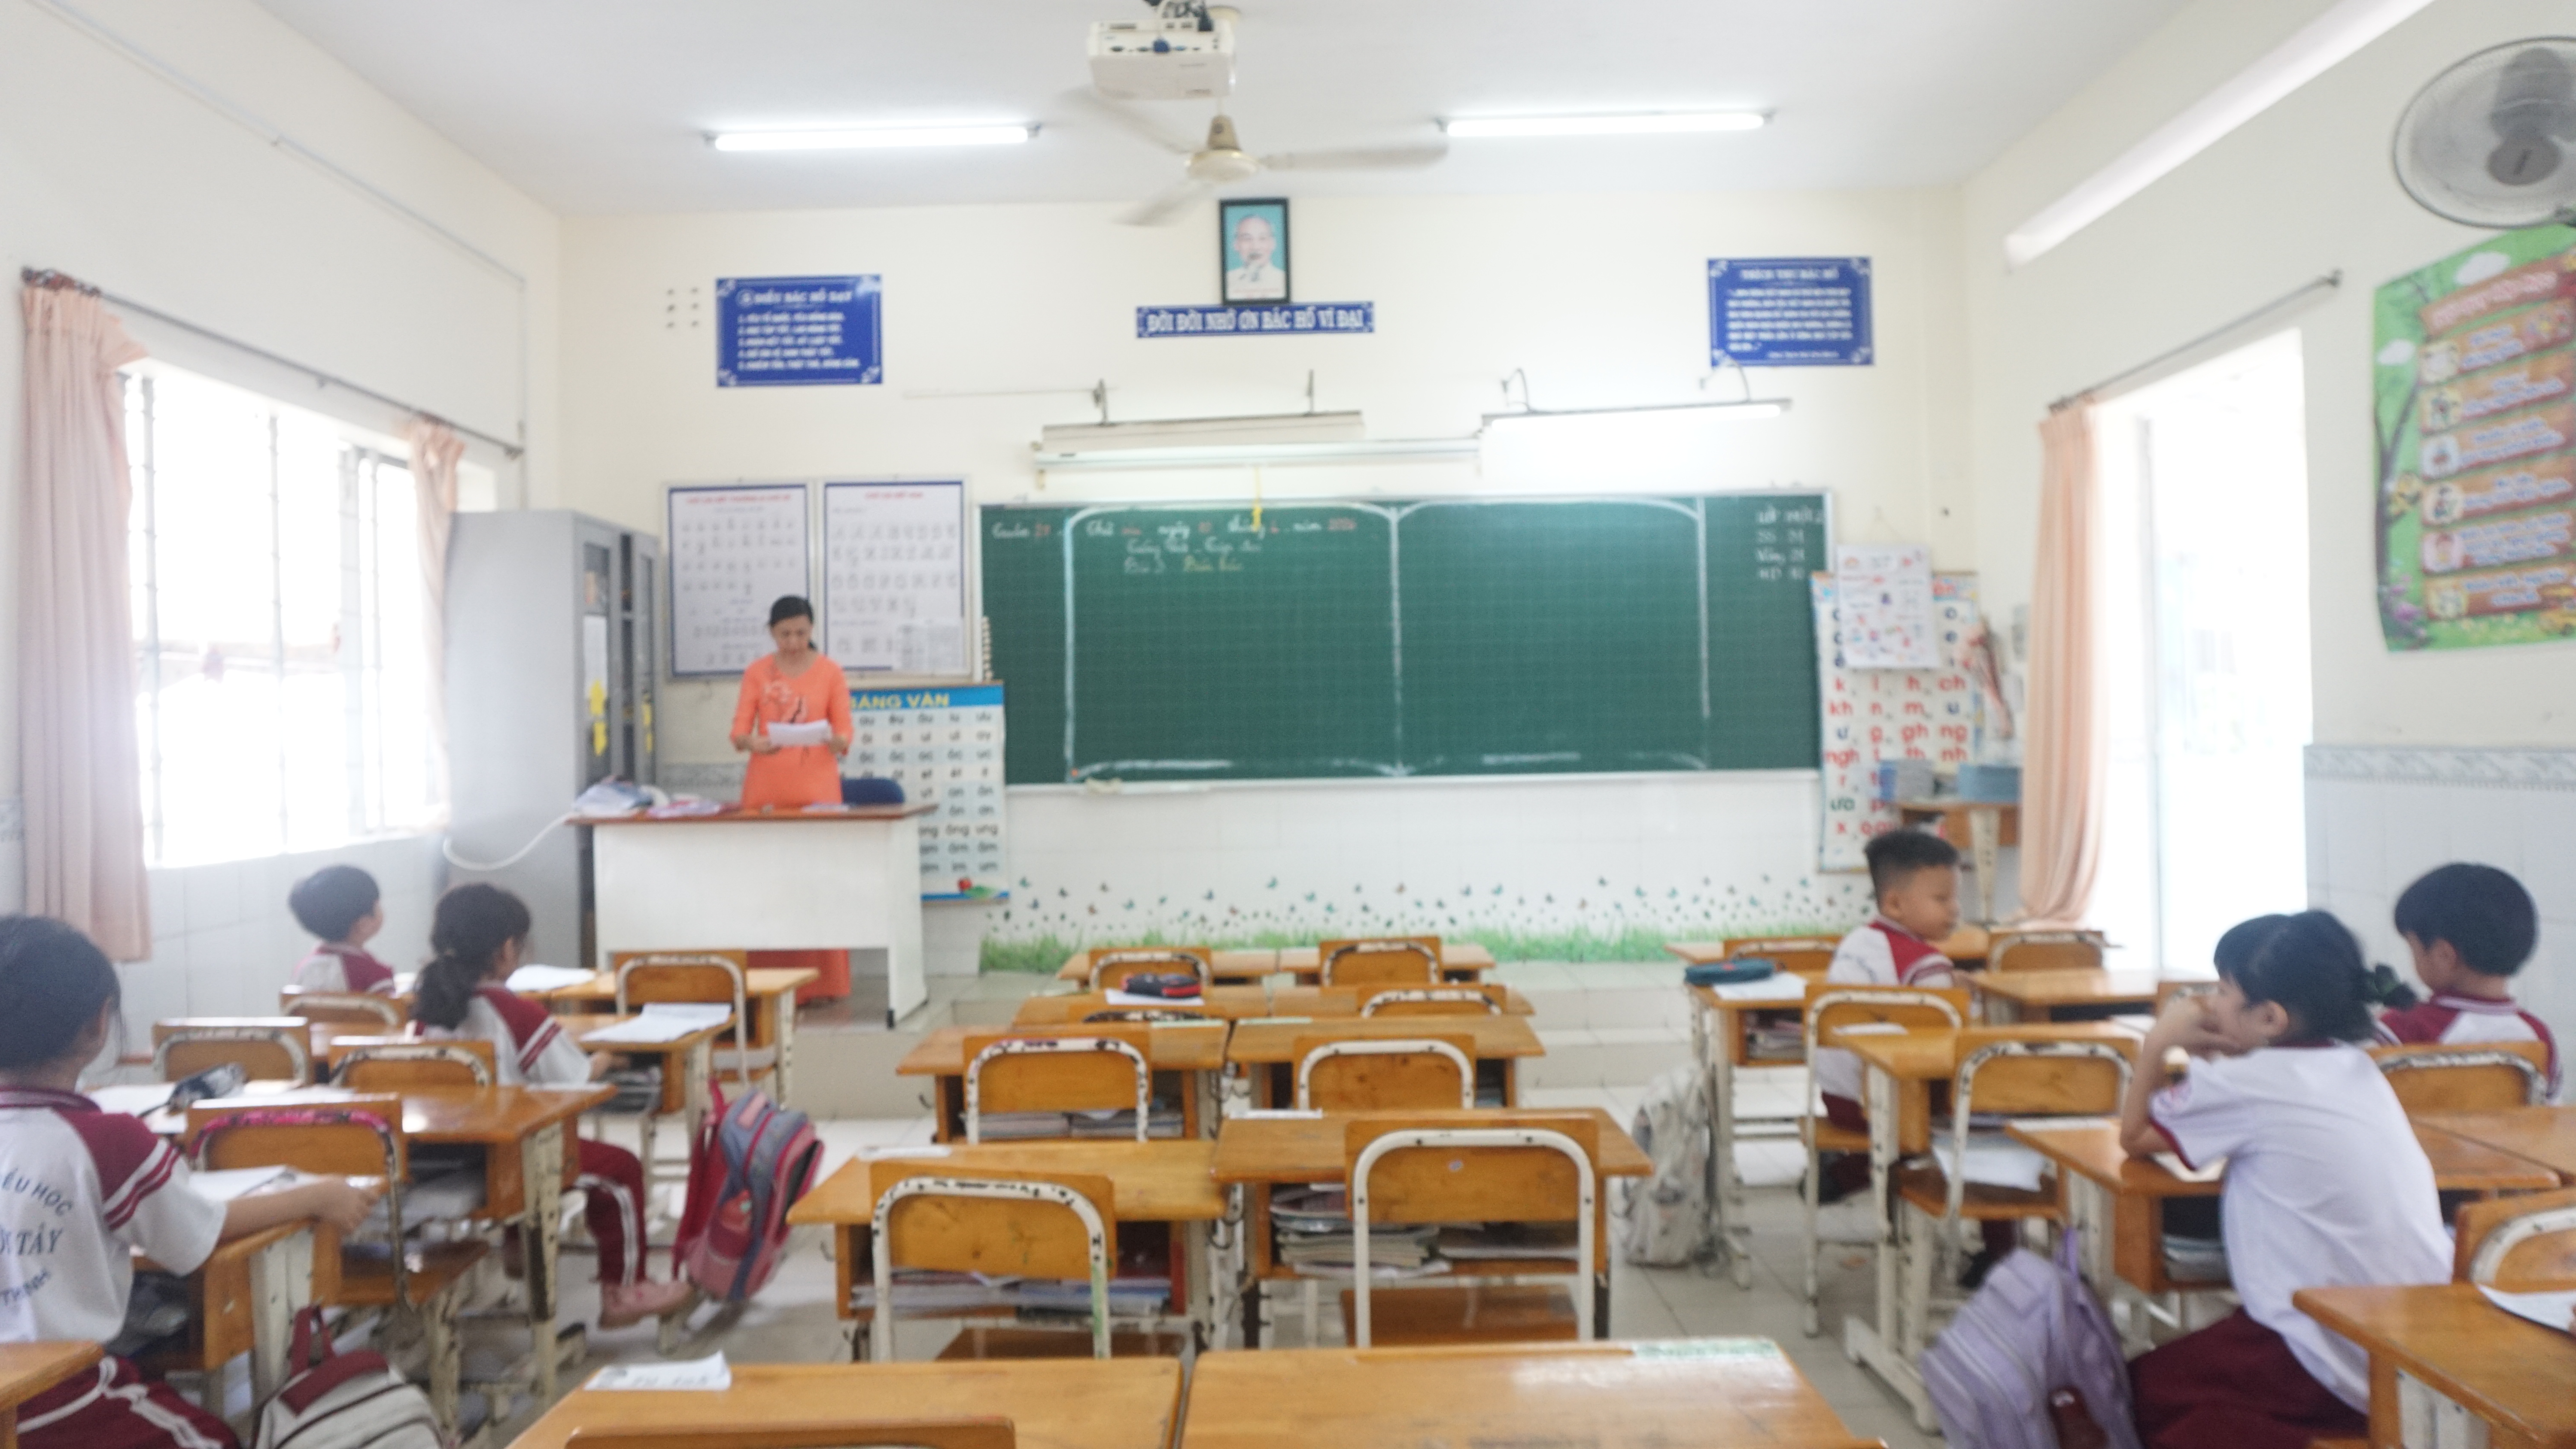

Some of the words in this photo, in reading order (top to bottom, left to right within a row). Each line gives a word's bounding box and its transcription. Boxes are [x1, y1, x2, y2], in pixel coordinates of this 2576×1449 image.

[1261, 306, 1291, 330] BÁC
[1908, 675, 1921, 691] h
[1938, 675, 1966, 691] ch
[1829, 700, 1853, 715] kh
[1871, 702, 1883, 715] n
[1904, 701, 1925, 715] m
[1902, 723, 1929, 743] gh
[1940, 724, 1968, 743] ng
[1826, 748, 1860, 769] ngh
[1941, 747, 1968, 762] nh
